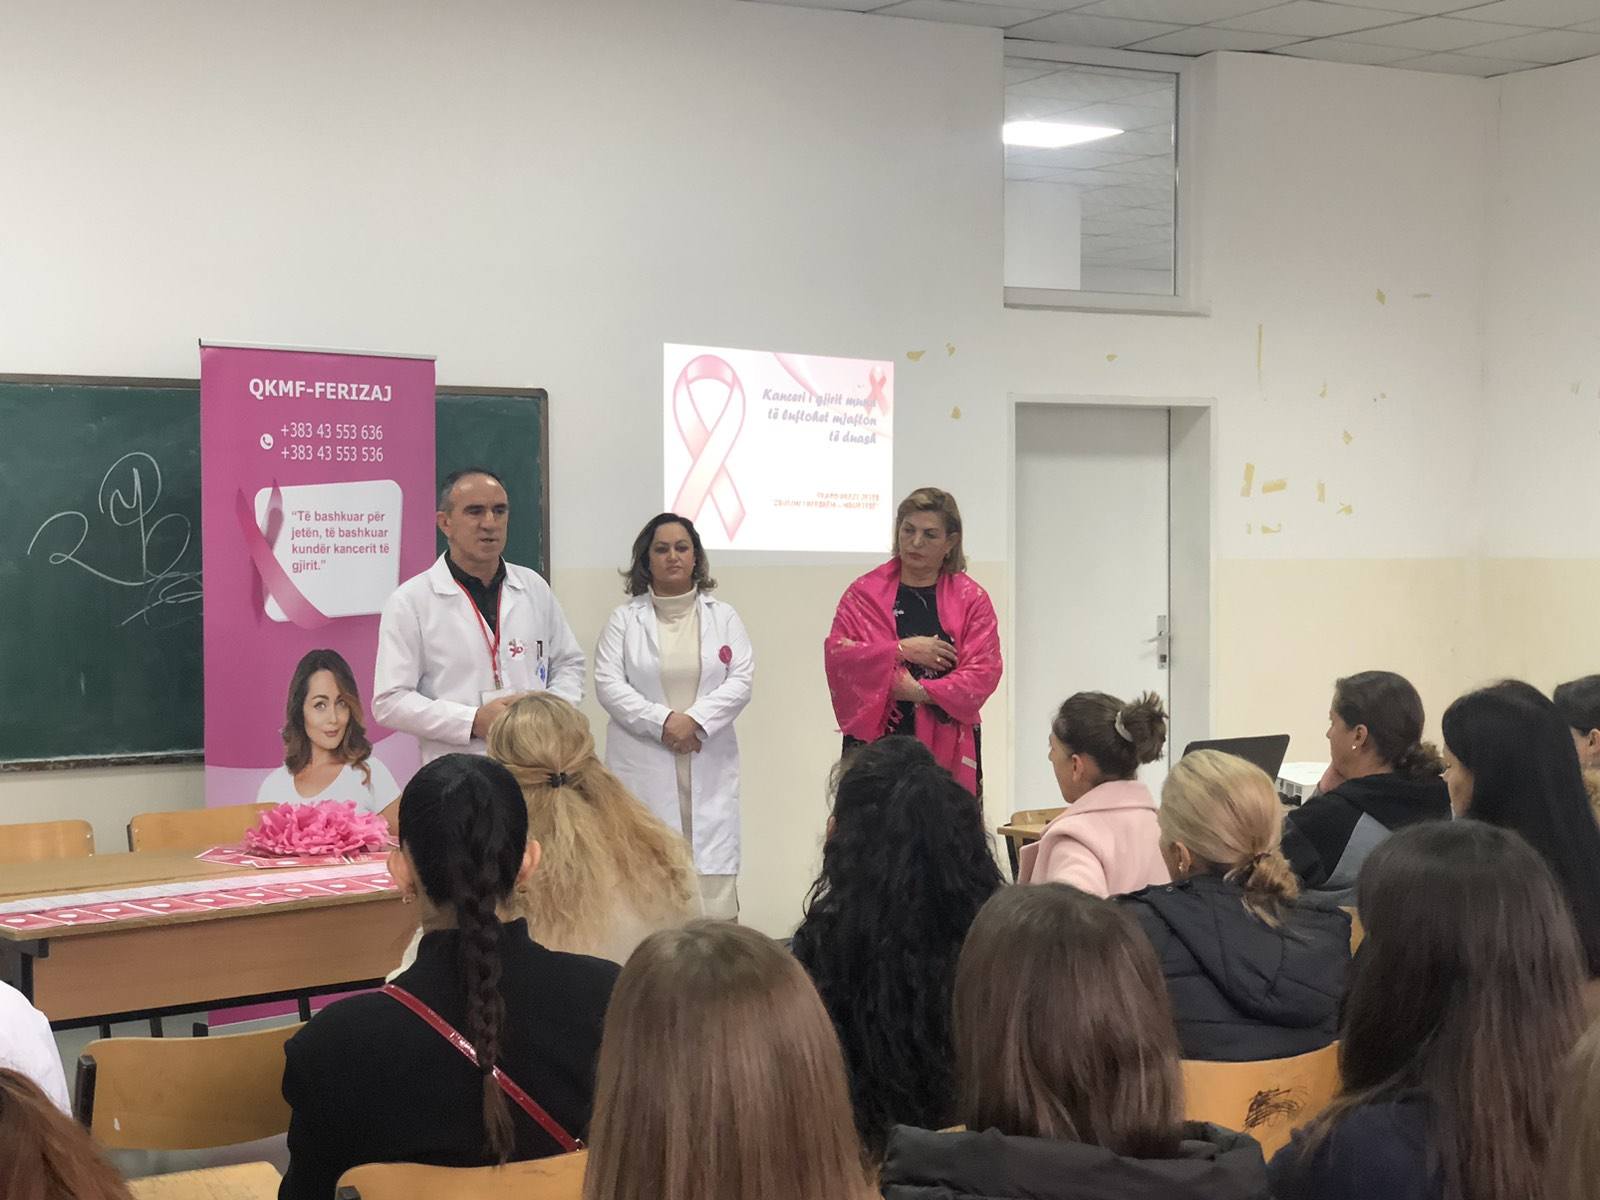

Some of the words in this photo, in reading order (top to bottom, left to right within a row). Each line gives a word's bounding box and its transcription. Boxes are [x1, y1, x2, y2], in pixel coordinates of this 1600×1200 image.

[249, 378, 392, 401] QKMF-FERIZAJ
[281, 422, 313, 438] +383
[317, 423, 332, 439] 43
[336, 424, 357, 439] 553
[361, 425, 383, 440] 636
[281, 445, 313, 460] +383
[317, 446, 332, 460] 43
[336, 446, 357, 461] 553
[362, 447, 384, 462] 536
[314, 511, 364, 522] bashkuar
[367, 512, 385, 523] për
[290, 527, 322, 540] jetën,
[325, 528, 335, 537] të
[339, 528, 389, 538] bashkuar
[292, 543, 331, 554] kundër
[334, 544, 377, 554] kancerit
[380, 544, 390, 554] të
